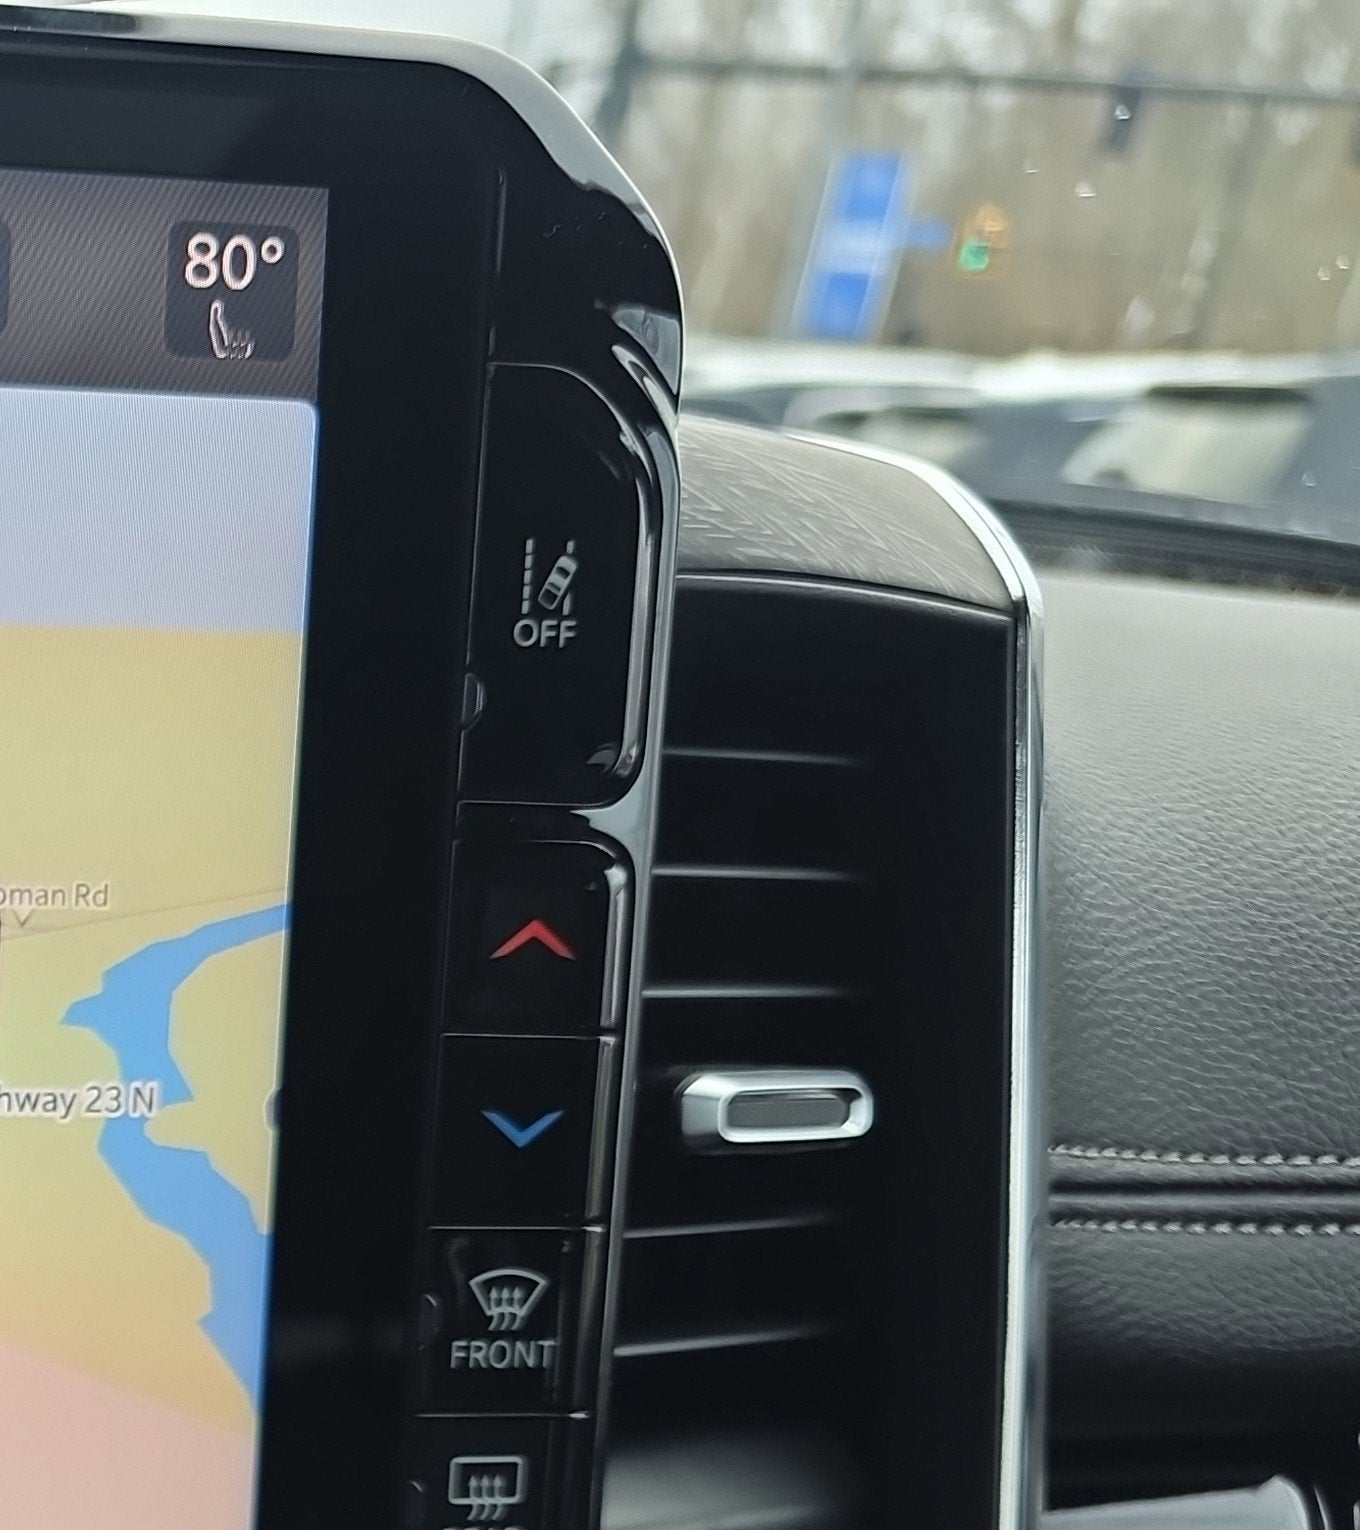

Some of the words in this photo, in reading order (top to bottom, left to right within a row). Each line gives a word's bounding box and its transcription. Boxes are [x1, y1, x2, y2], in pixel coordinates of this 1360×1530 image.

[184, 234, 284, 290] 80°
[514, 620, 577, 648] OFF
[75, 883, 109, 907] Rd
[86, 1087, 122, 1112] 23
[134, 1088, 155, 1113] N
[450, 1340, 557, 1370] FRONT
